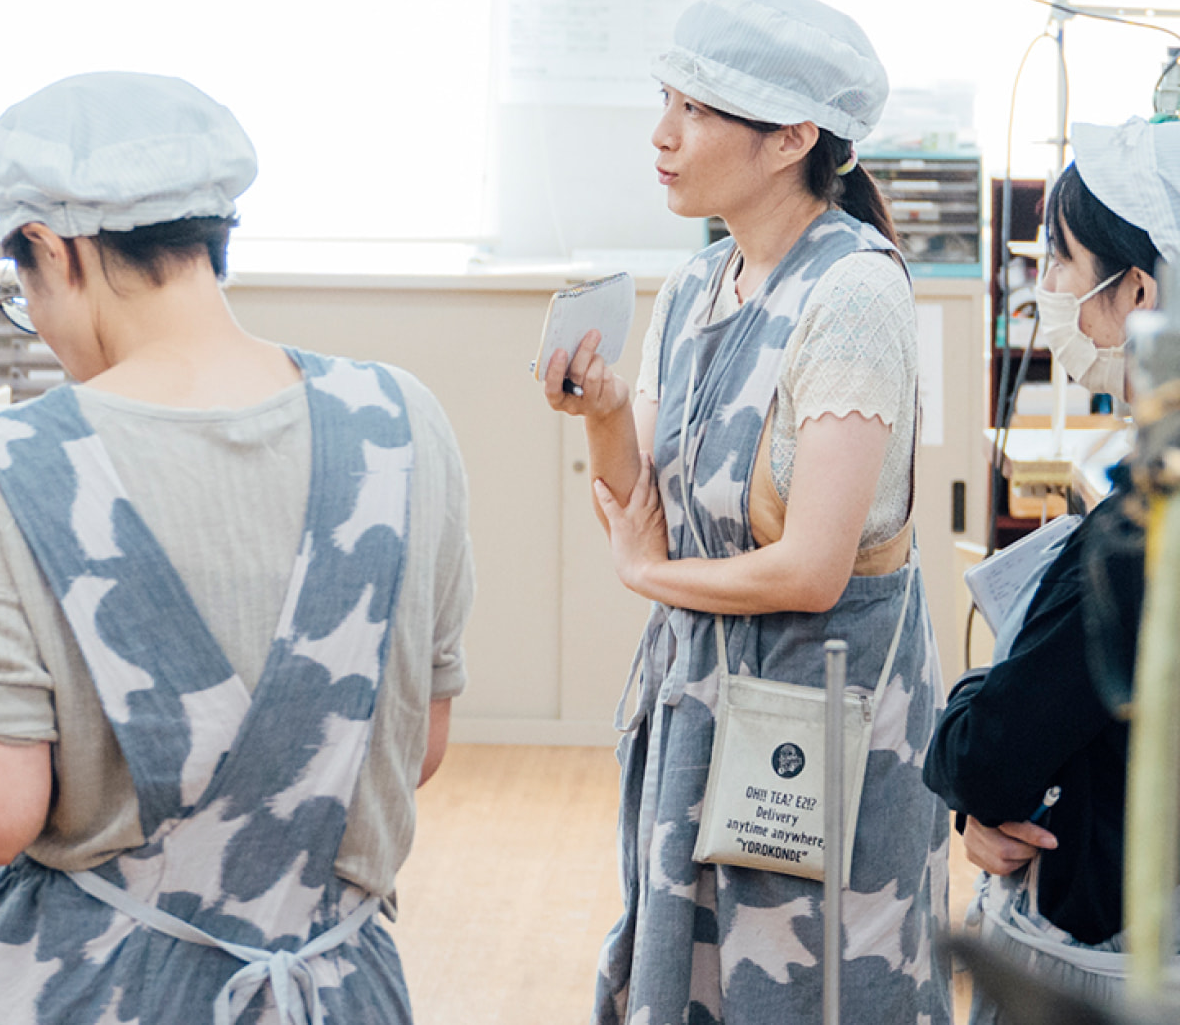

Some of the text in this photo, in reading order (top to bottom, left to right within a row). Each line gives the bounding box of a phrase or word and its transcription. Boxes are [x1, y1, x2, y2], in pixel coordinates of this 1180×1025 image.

[770, 790, 793, 807] TEA?
[756, 805, 799, 827] Delivery
[726, 819, 769, 837] anytime
